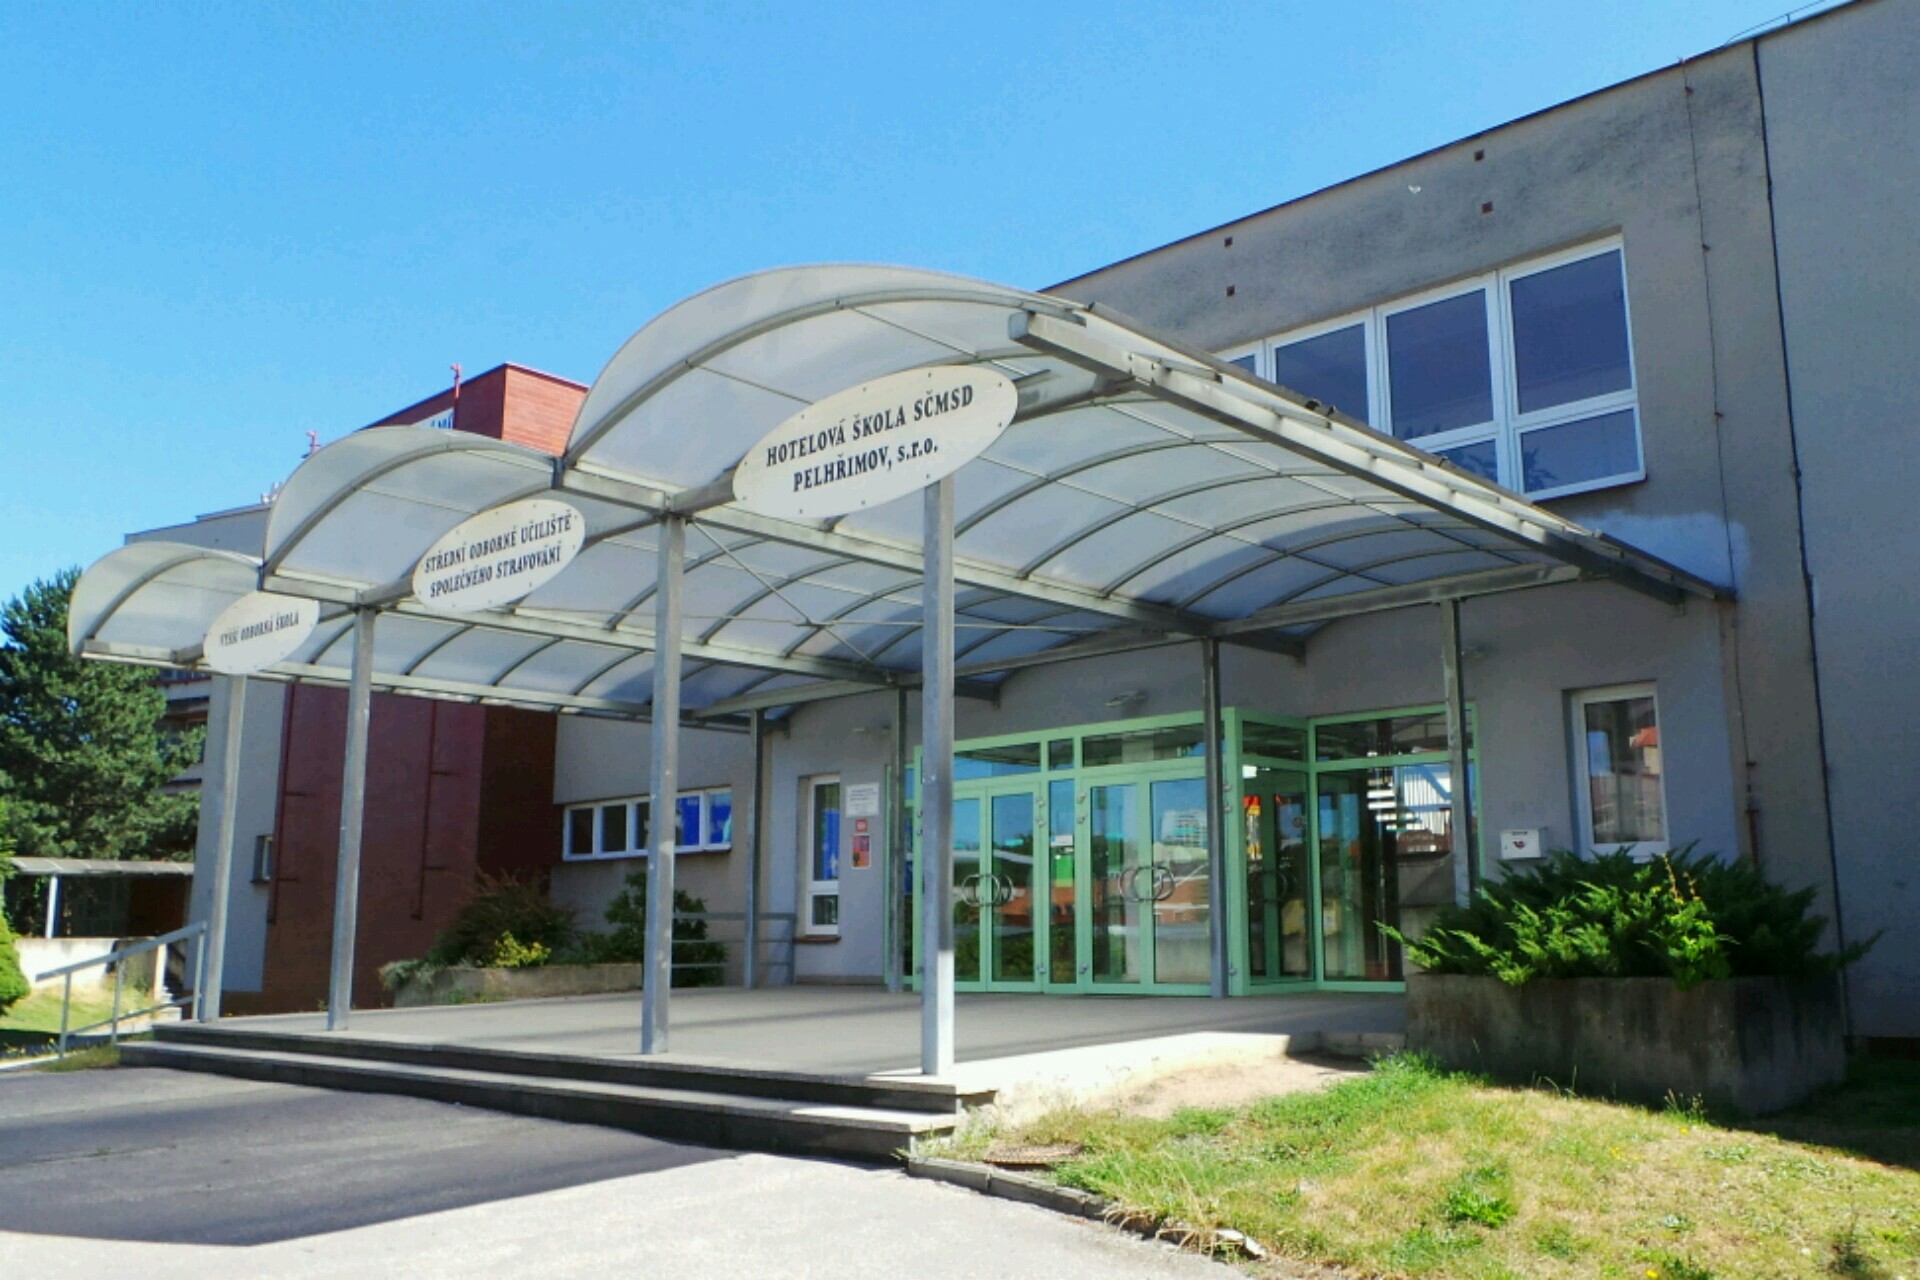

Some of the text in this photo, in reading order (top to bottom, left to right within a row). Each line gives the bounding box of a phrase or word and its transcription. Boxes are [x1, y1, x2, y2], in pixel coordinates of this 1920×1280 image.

[766, 384, 974, 467] HOTELOVÁ ŠKOLA SČMSD
[793, 437, 939, 492] PELHŘIMOV, s.r.o.
[424, 509, 572, 573] STŘEDNÍ ODBORNÉ UČILIŠTĚ
[430, 540, 563, 598] SPOLEČNÉHO STRAVOVÁNÍ
